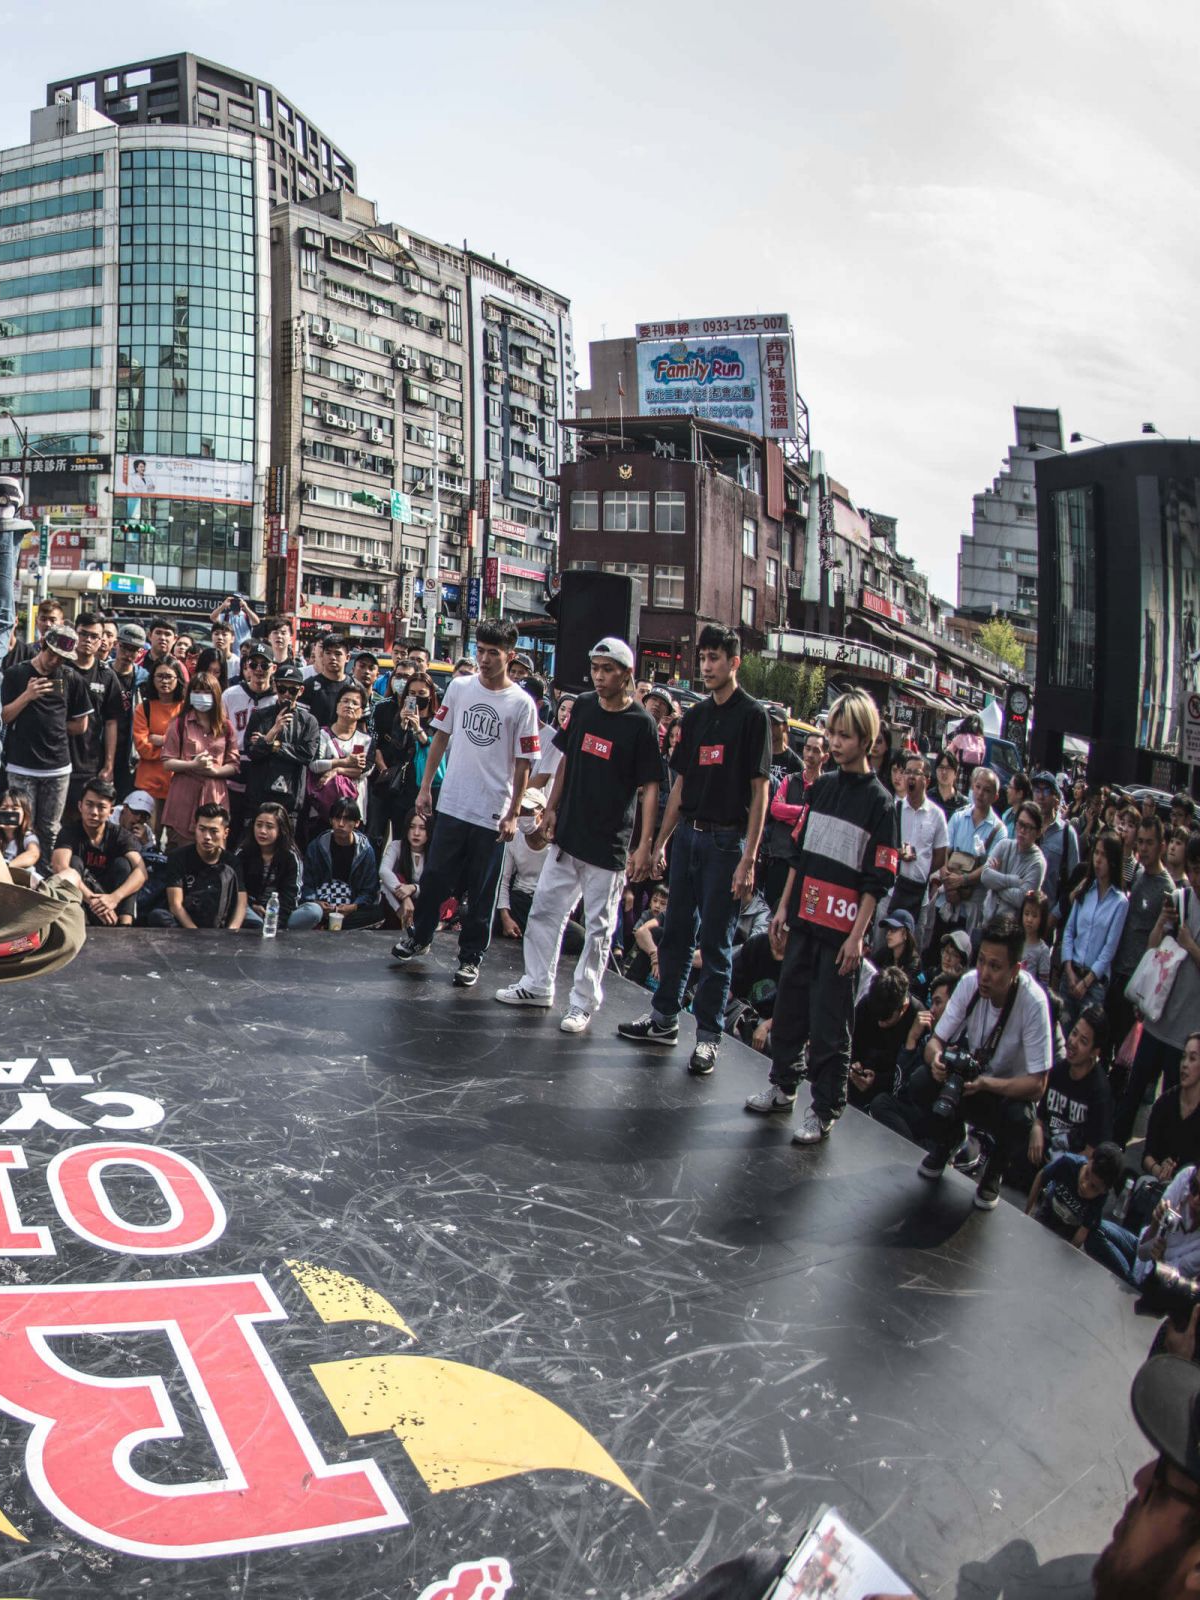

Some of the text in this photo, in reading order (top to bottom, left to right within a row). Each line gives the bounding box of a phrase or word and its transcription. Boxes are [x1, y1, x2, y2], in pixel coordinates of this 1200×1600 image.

[703, 317, 783, 333] 0933-125-007
[656, 358, 741, 381] Family Run
[766, 341, 789, 430] 西門紅樓電視牆
[462, 711, 502, 738] DICKIES
[594, 742, 607, 753] 128
[825, 895, 858, 922] 130
